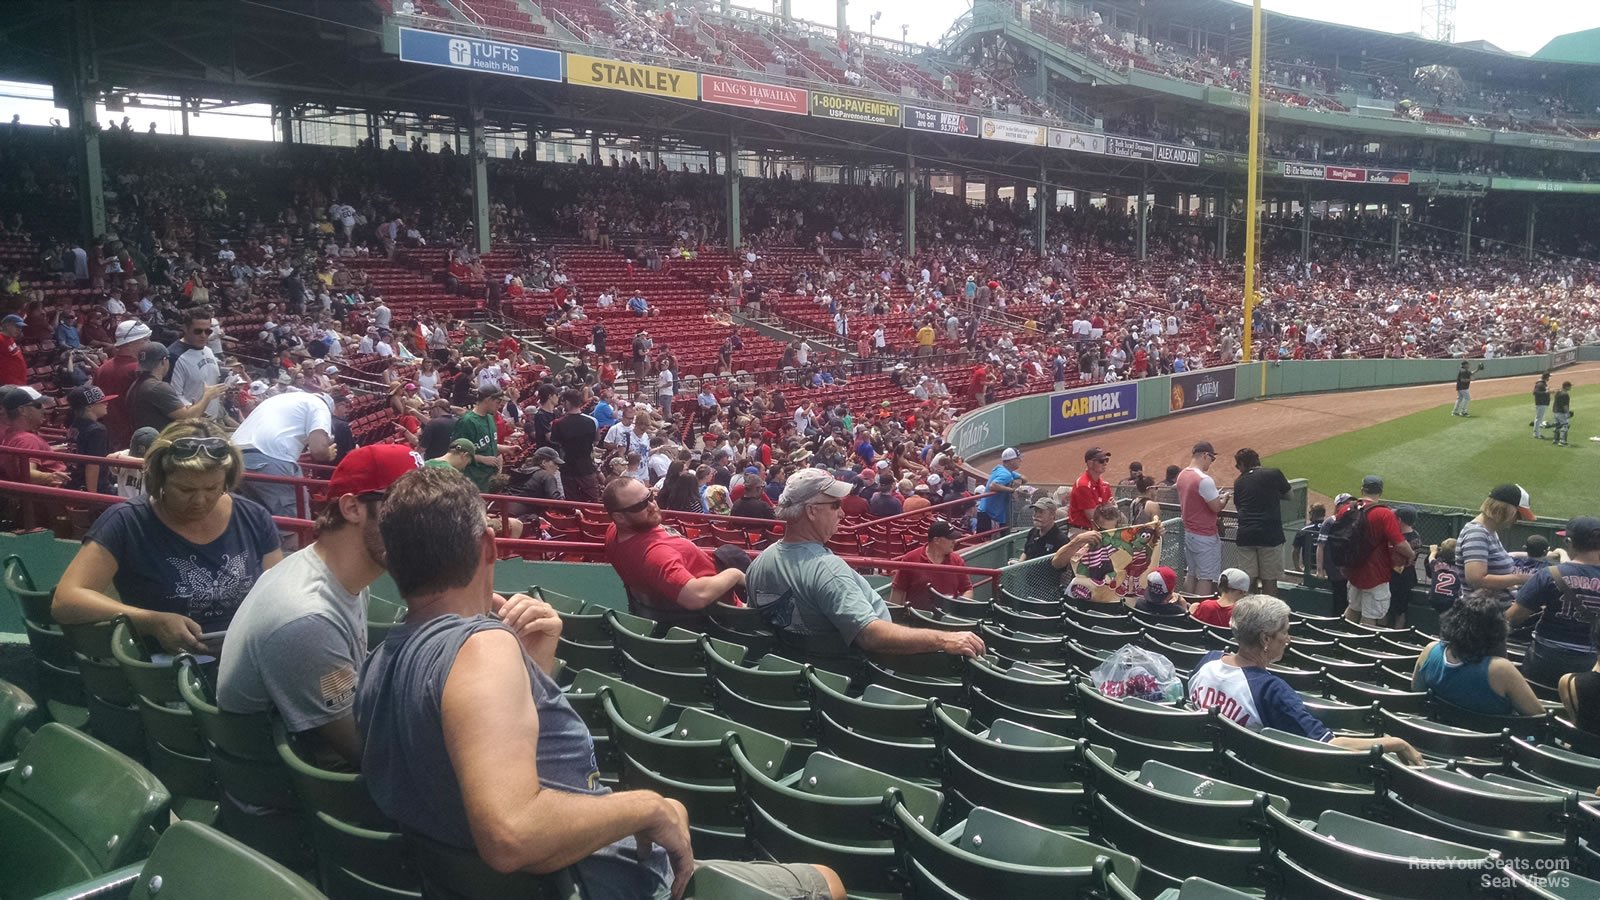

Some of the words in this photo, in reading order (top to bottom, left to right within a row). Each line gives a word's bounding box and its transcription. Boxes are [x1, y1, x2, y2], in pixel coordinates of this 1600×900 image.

[472, 41, 519, 62] TUFTS
[473, 58, 500, 70] Health
[501, 63, 519, 73] Plan
[591, 62, 680, 92] STANLEY
[713, 80, 747, 95] KING'S
[749, 84, 797, 102] HAWAIIAN
[813, 95, 900, 117] 1-800-PAVEMENT
[829, 109, 886, 123] USPavement.com
[915, 111, 925, 120] The
[926, 112, 936, 122] Sox
[940, 113, 960, 125] WEEI
[1158, 147, 1173, 160] ALEX
[1173, 150, 1186, 162] AND
[1186, 152, 1197, 163] ANI
[1195, 381, 1219, 401] KAYEM
[1435, 573, 1455, 596] 2
